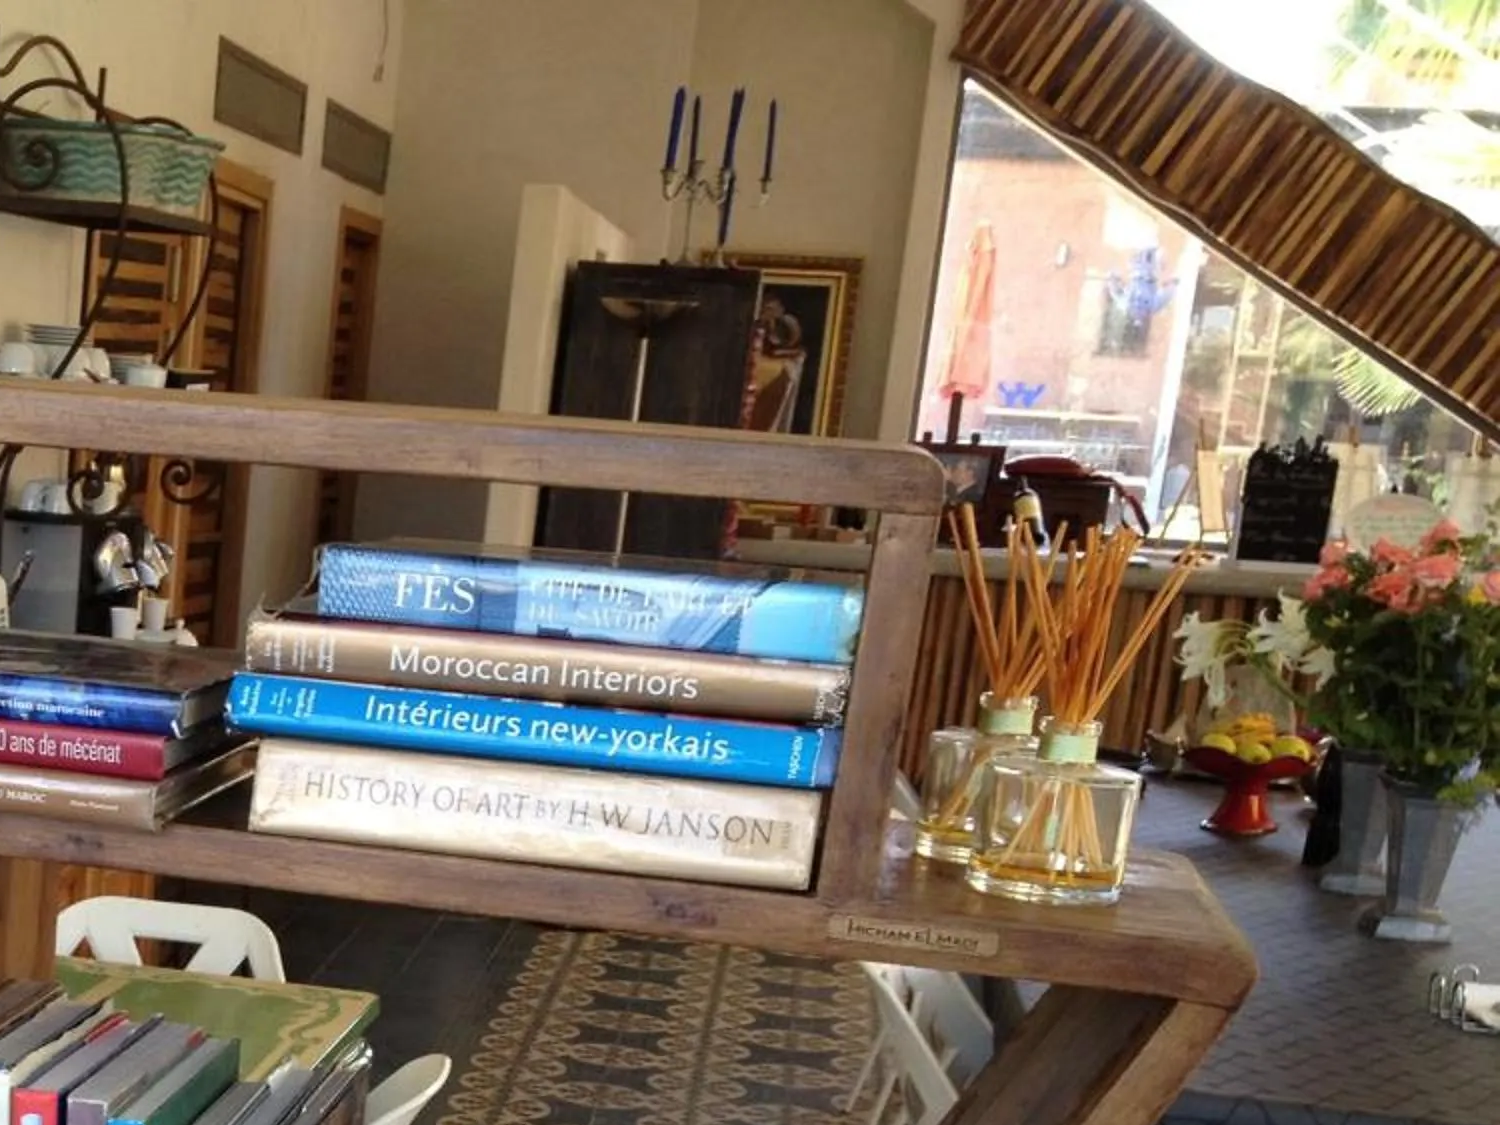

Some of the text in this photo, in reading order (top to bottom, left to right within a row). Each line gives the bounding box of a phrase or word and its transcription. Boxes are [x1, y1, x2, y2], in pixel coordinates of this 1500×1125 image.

[389, 644, 699, 700] Moroccan Interiors
[8, 734, 35, 755] ans
[38, 733, 57, 756] de
[59, 736, 121, 765] mécénat
[364, 694, 521, 739] Intérieurs
[530, 715, 730, 764] new-yorkais
[304, 770, 422, 810] HISTORY
[432, 786, 471, 812] OF
[474, 792, 529, 819] ART
[535, 798, 562, 818] BY
[641, 808, 775, 847] JANSON
